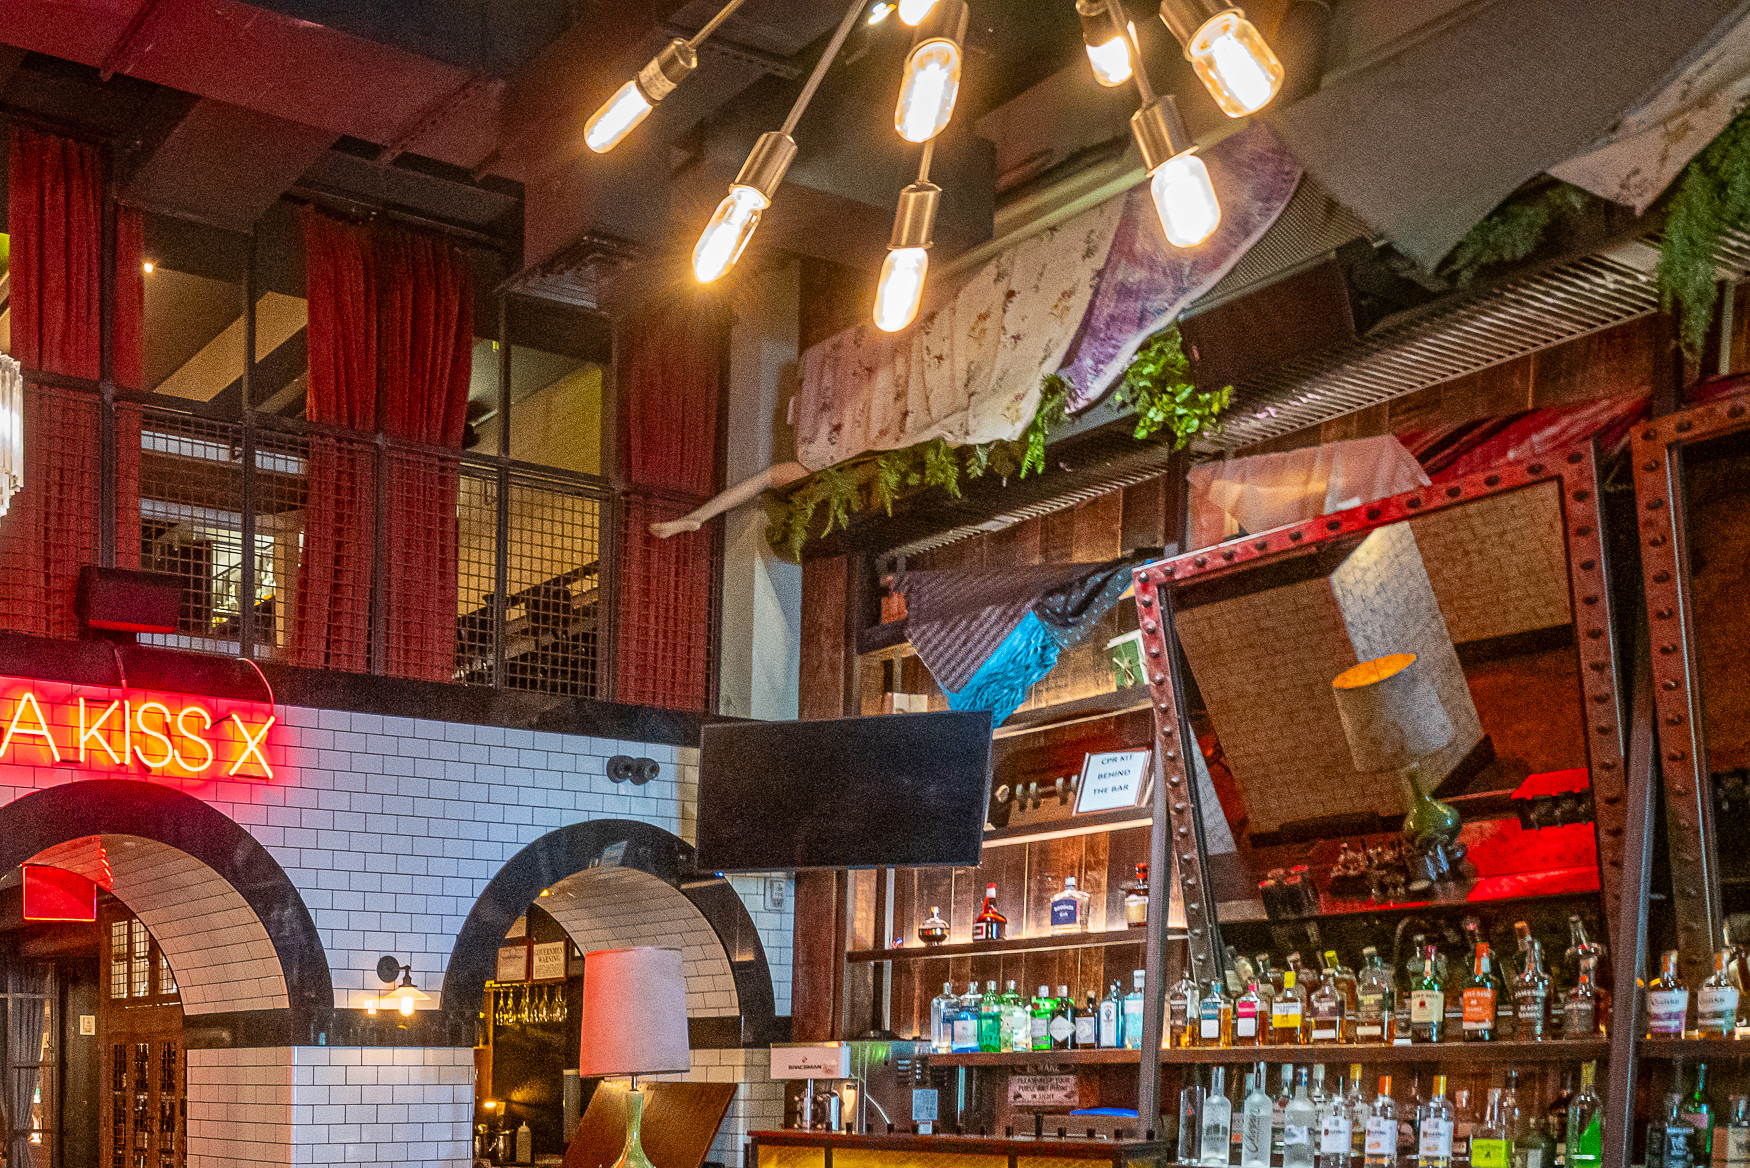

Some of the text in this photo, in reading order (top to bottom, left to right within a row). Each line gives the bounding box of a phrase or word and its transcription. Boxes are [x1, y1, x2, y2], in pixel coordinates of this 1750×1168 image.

[78, 697, 214, 773] KISS
[227, 713, 275, 780] X
[1100, 753, 1134, 766] CPR KIT
[1097, 768, 1131, 780] BEHIND
[1093, 784, 1129, 796] THE BAR
